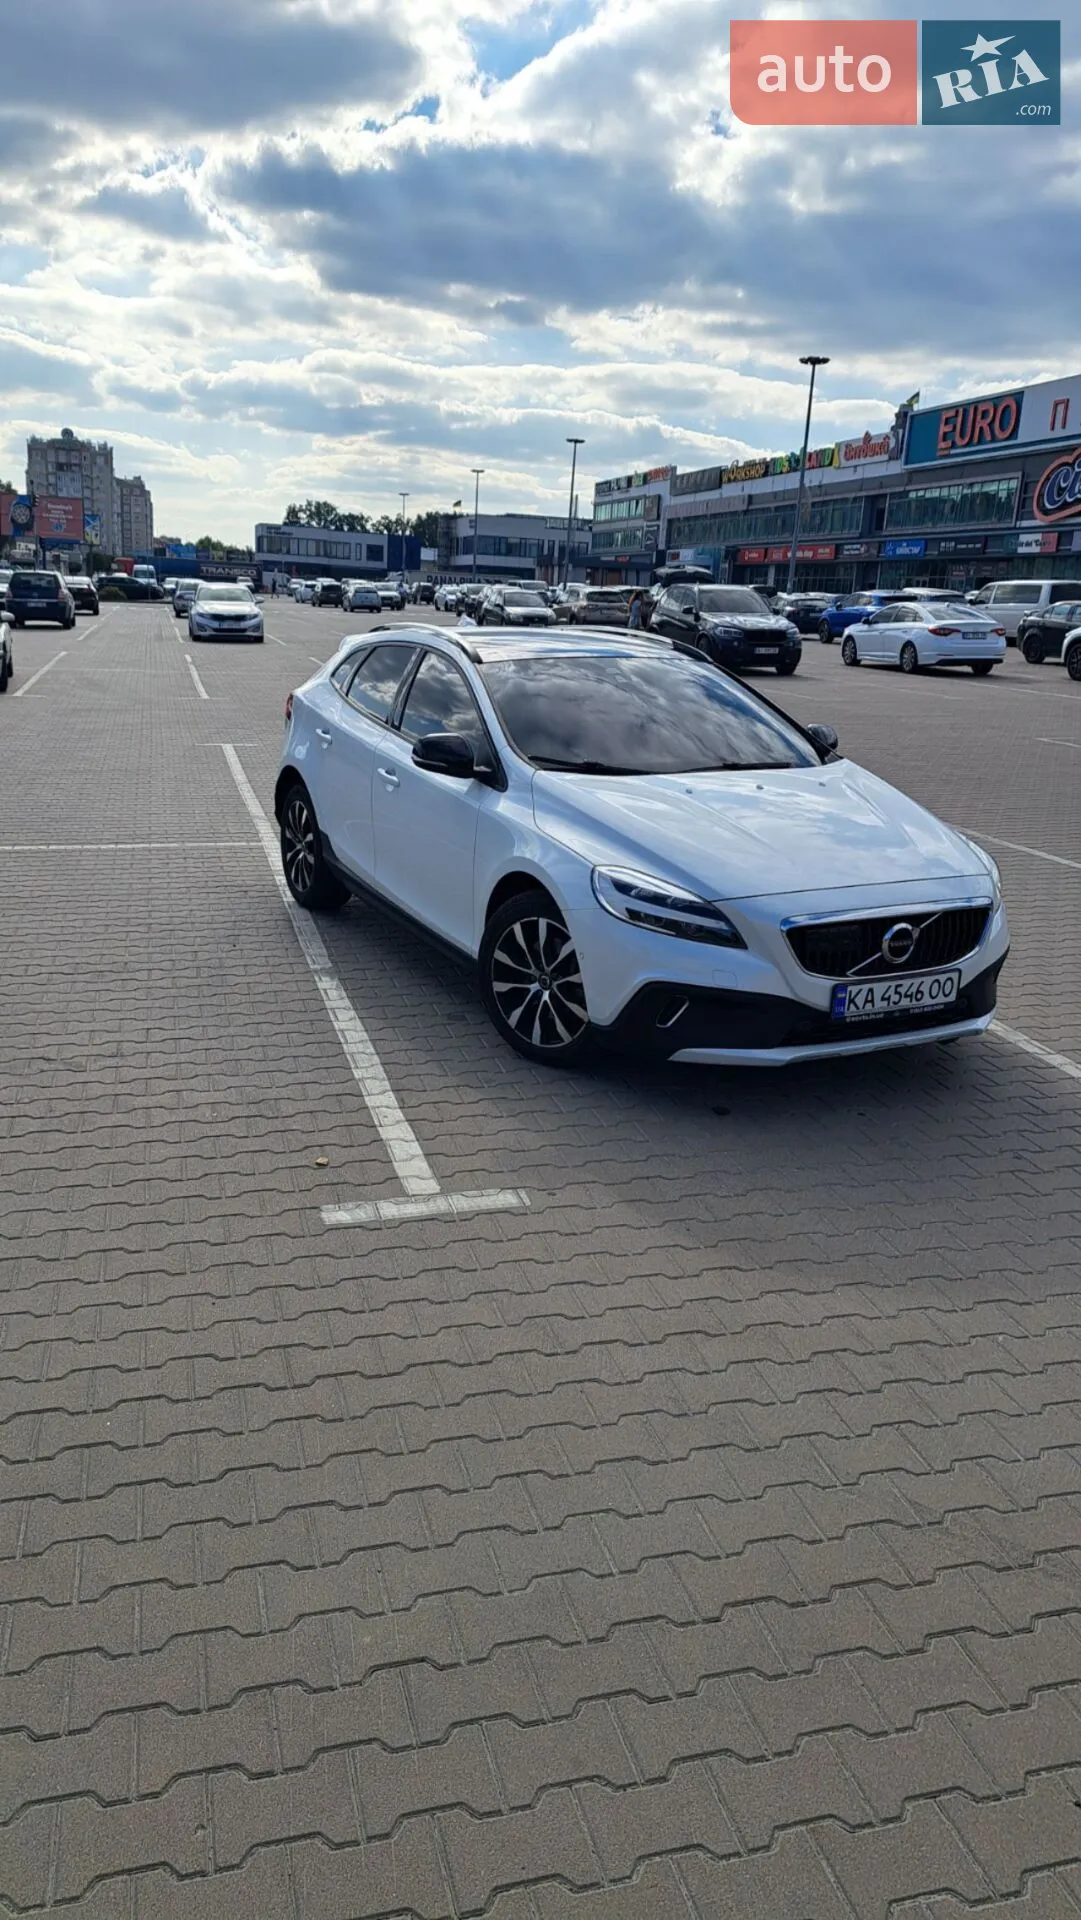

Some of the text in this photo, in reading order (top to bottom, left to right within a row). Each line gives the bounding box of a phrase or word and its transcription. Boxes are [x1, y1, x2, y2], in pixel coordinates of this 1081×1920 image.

[938, 396, 1017, 449] EURO
[202, 566, 257, 576] TRANSCO
[847, 987, 875, 1011] KA
[881, 981, 925, 1006] 4546
